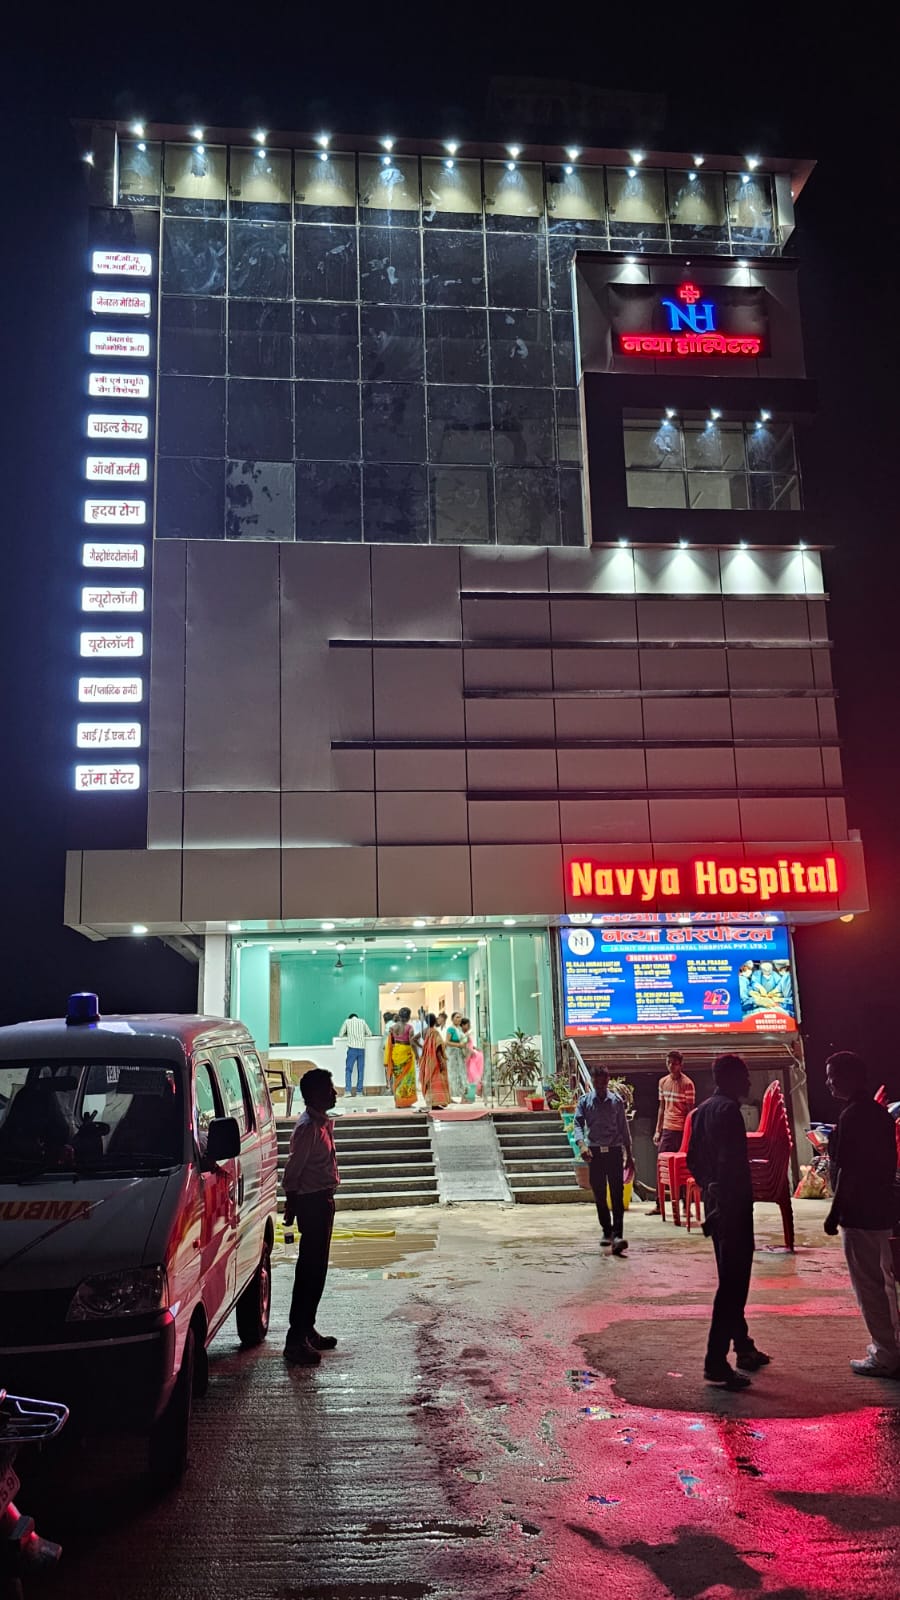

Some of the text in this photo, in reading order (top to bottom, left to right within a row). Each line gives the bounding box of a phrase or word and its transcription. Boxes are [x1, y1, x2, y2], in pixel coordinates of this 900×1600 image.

[622, 334, 760, 354] नव्या हॉस्पिटल
[92, 418, 143, 434] चाइल्ड केयर
[91, 502, 141, 520] हृदय रोग
[87, 634, 135, 653] यूरोलॉजी
[80, 769, 108, 787] ट्रॉमा
[570, 857, 839, 901] Navya Hospital
[601, 928, 662, 943] नव्या
